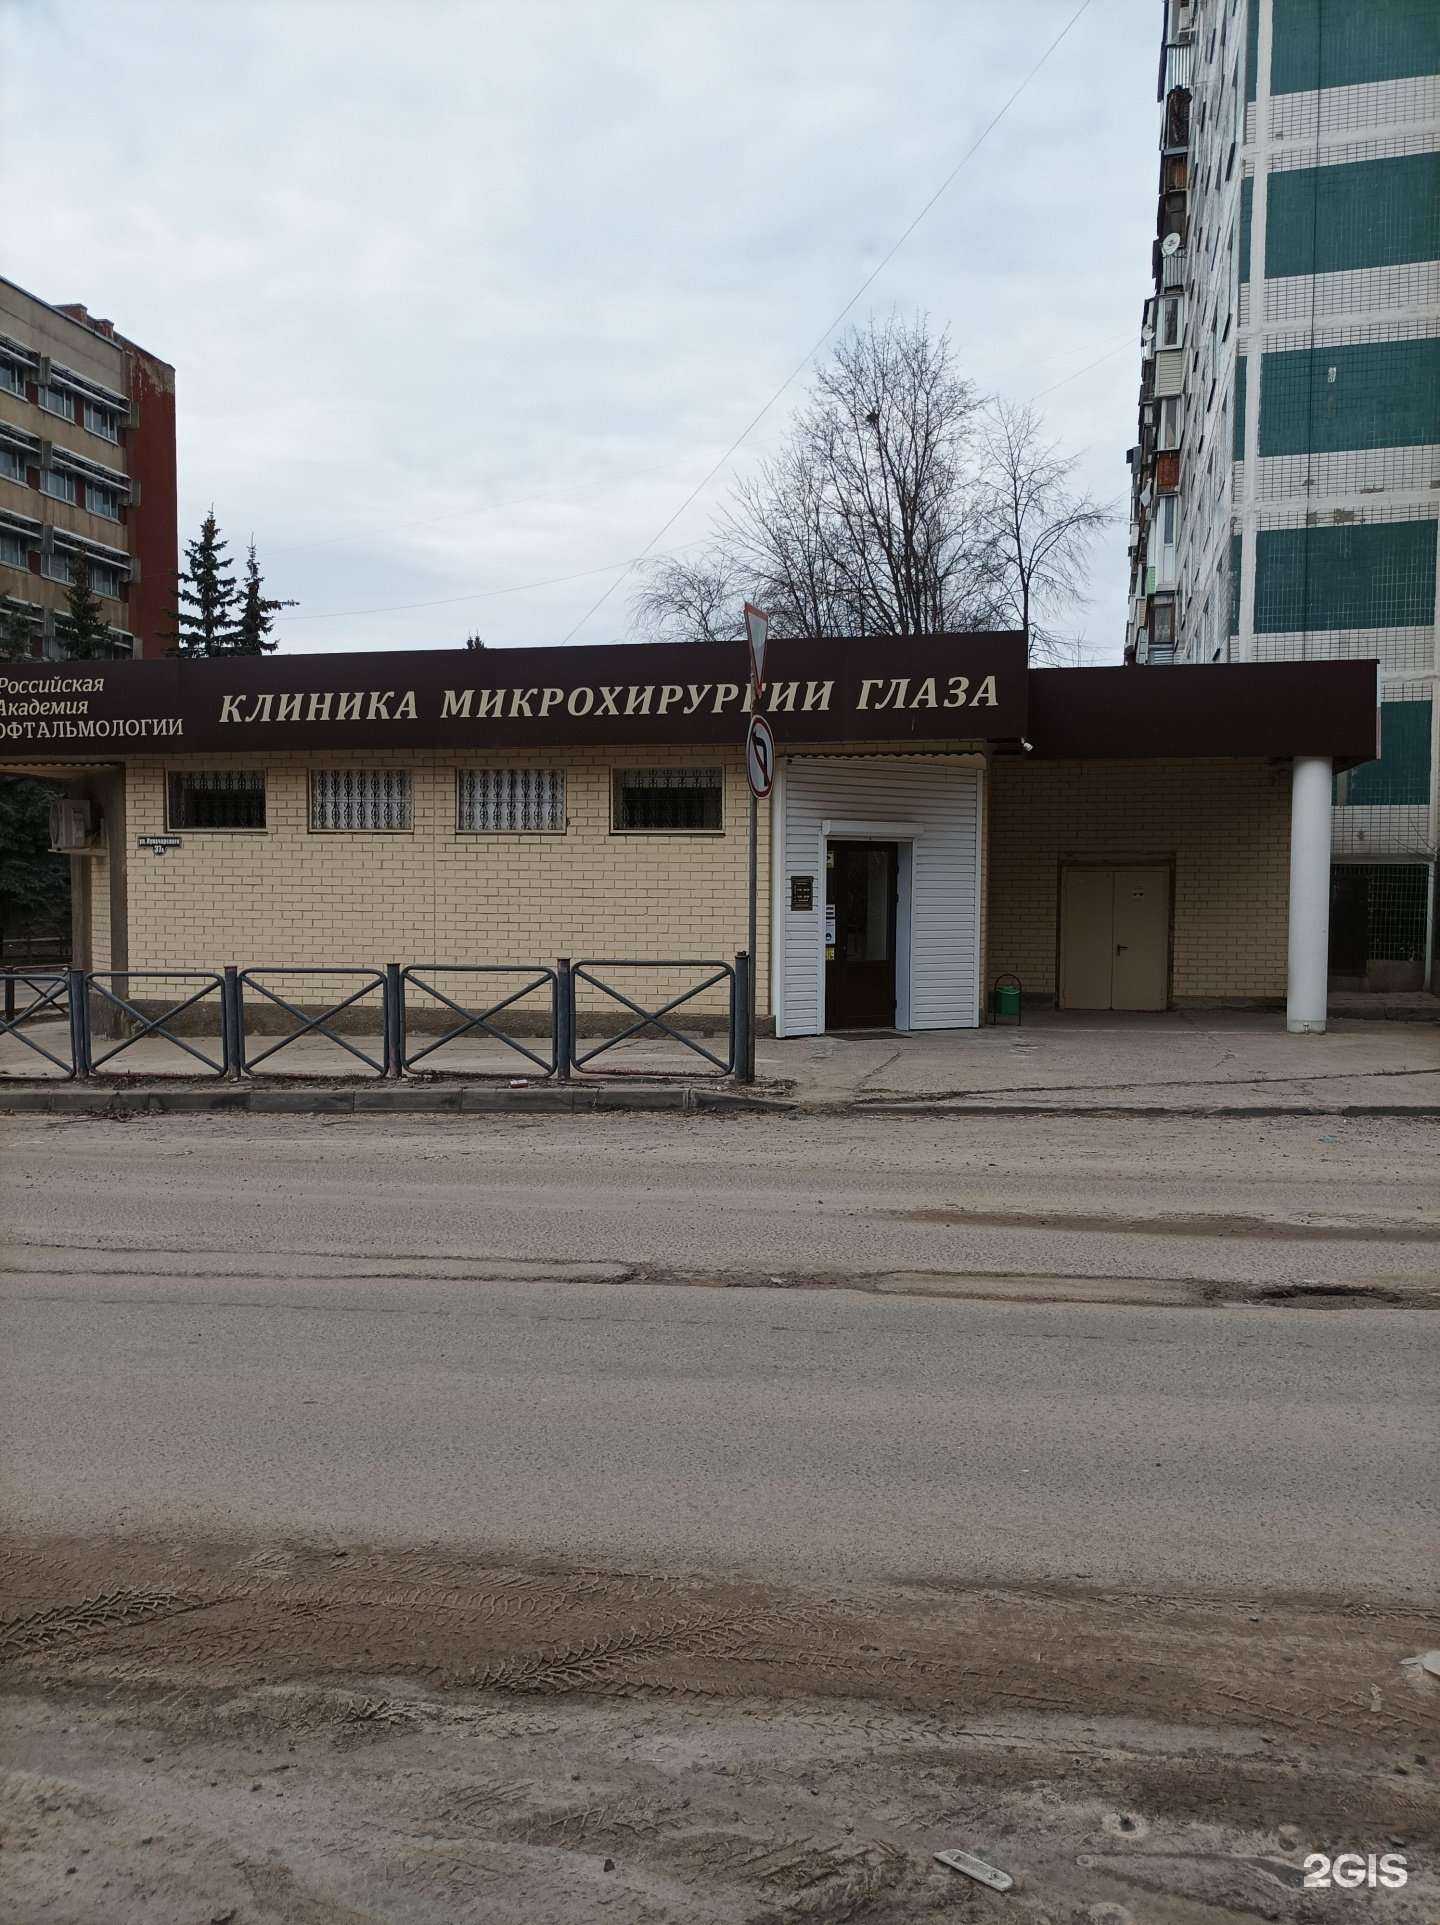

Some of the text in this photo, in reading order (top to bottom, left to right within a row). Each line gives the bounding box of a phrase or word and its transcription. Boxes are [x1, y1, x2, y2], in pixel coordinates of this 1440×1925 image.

[0, 676, 105, 694] Российская
[0, 698, 89, 716] Академия
[218, 675, 999, 723] КЛИНИКА МИКРОХИРУРГИИ ГЛАЗА
